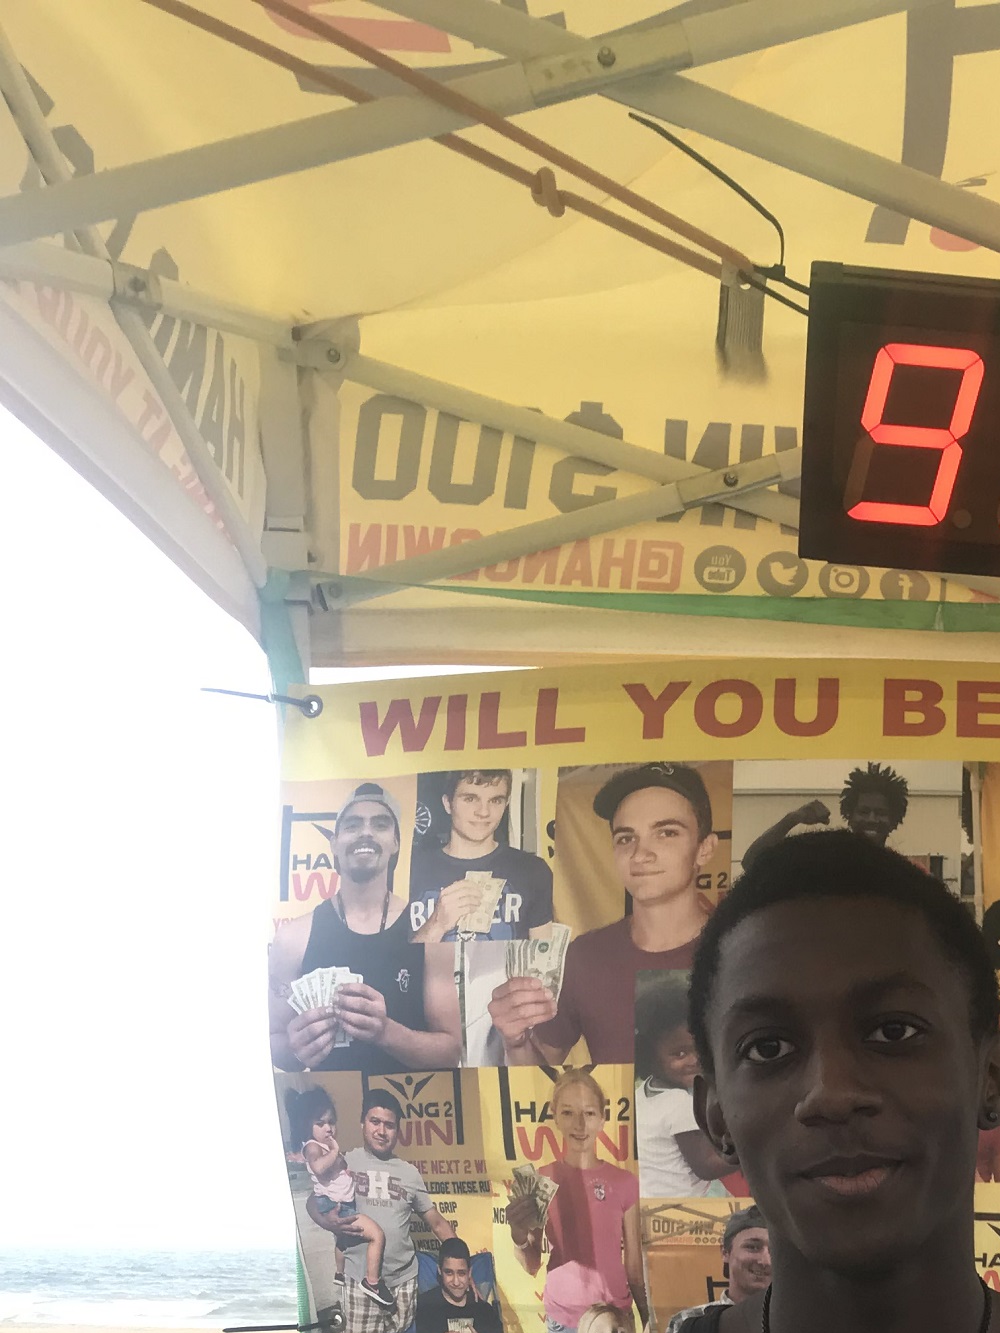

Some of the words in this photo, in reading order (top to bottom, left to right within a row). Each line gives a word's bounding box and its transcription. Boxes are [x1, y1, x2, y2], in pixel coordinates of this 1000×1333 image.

[359, 688, 586, 757] WILL
[621, 677, 840, 740] YOU
[292, 852, 336, 871] HA
[399, 1102, 439, 1118] ANG
[444, 1101, 453, 1118] 2
[617, 1097, 631, 1122] 2
[516, 1125, 629, 1162] WN
[431, 1160, 460, 1175] NEXT
[464, 1160, 472, 1175] 2
[452, 1180, 478, 1195] THESE
[439, 1201, 458, 1213] GRIP
